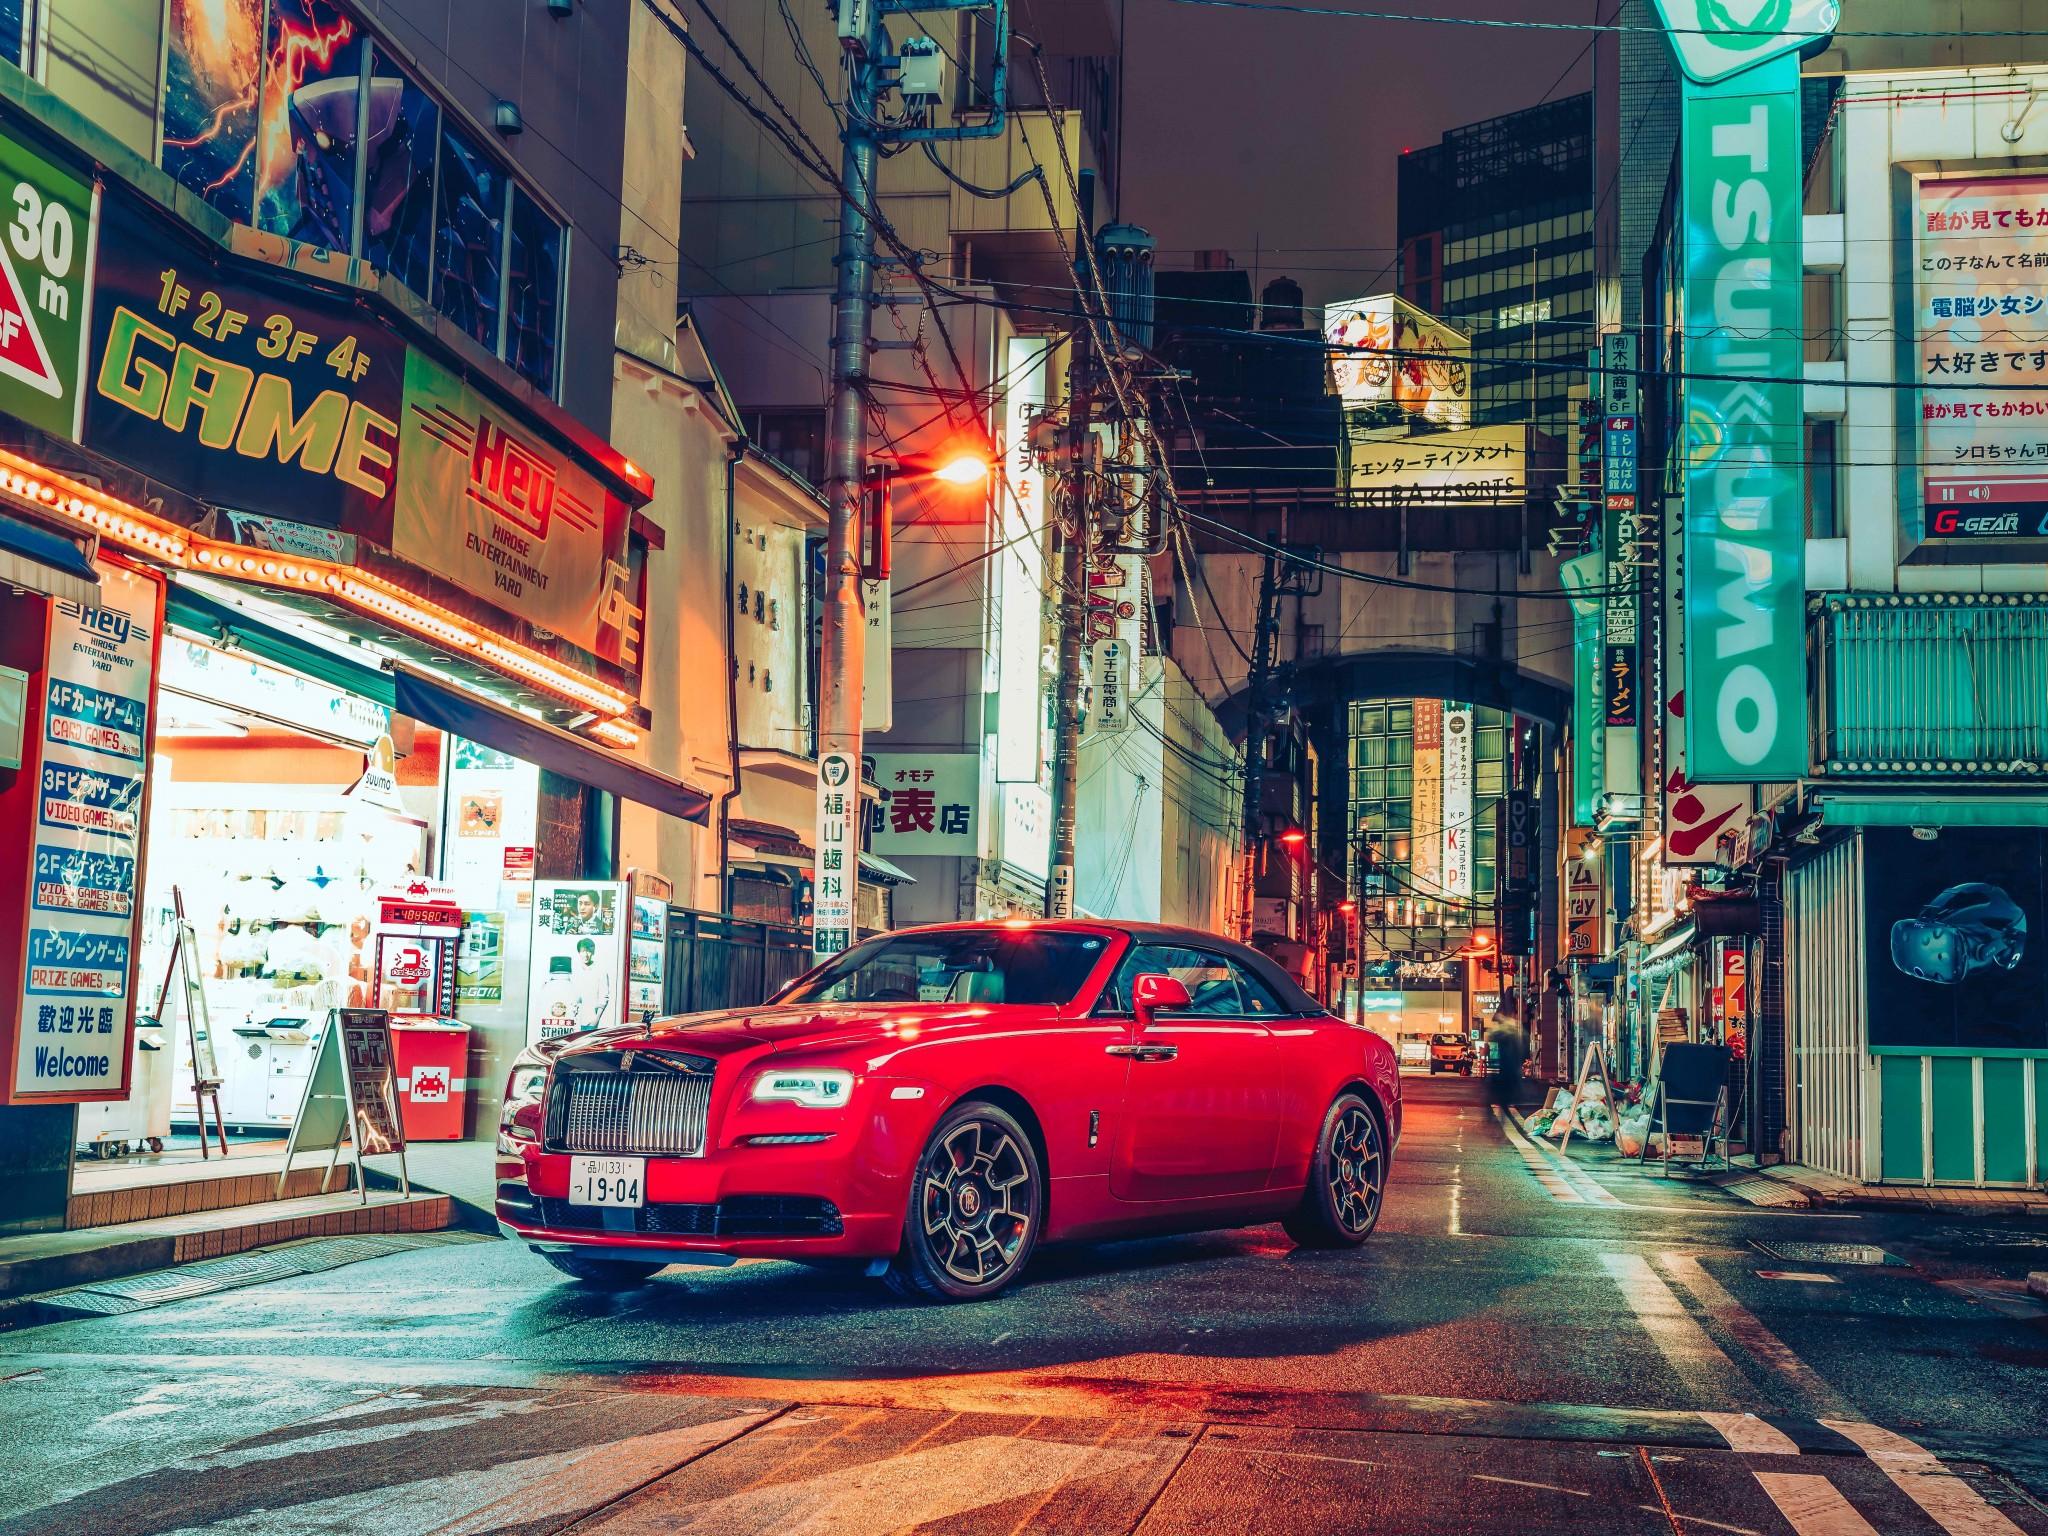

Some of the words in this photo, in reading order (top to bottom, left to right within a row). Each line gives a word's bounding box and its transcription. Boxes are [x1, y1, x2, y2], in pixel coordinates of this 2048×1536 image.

[9, 182, 73, 278] 30
[1921, 252, 2048, 271] この子なんて名前
[39, 274, 68, 321] m
[158, 268, 190, 317] 1F
[193, 291, 248, 342] 2F
[256, 314, 318, 362] 3F
[326, 335, 371, 382] 4F
[1927, 350, 2048, 375] 大好きです
[97, 305, 398, 499] GAME
[1609, 402, 1631, 412] 6F
[1612, 418, 1629, 430] 4F
[1711, 104, 1778, 767] TSUKUMO
[1620, 433, 1633, 490] らしんばん
[466, 413, 557, 543] Hey
[1607, 498, 1634, 508] 2F/3F
[1934, 509, 2019, 533] G-GEAR
[492, 524, 530, 558] HIROSE
[466, 532, 548, 590] ENTERTAINMENT
[494, 571, 522, 598] YARD
[79, 603, 132, 644] Hey
[73, 642, 134, 667] ENTERTAINMENT
[90, 636, 118, 652] HIROSE
[91, 658, 112, 673] YARD
[1103, 658, 1117, 708] 千石電商
[1611, 662, 1630, 715] ラーメン
[52, 717, 82, 741] CARD
[85, 726, 120, 750] GAMES
[895, 769, 935, 782] オモテ
[46, 801, 80, 821] VIDEO
[83, 808, 114, 829] GAMES
[1511, 801, 1526, 846] DVD
[822, 793, 844, 898] 福山歯科
[38, 852, 61, 875] 2F
[1569, 862, 1593, 885] ム
[40, 883, 74, 897] VIDE
[77, 888, 110, 901] GAMES
[77, 898, 108, 912] GAMES
[1054, 889, 1067, 918] 千石
[32, 969, 68, 987] PRIZE
[70, 971, 102, 988] GAMES
[37, 1004, 114, 1035] 歡迎光臨
[35, 1046, 109, 1078] Welcome
[587, 1160, 608, 1174] 品川
[609, 1161, 625, 1175] 331
[587, 1177, 638, 1203] 19-04
